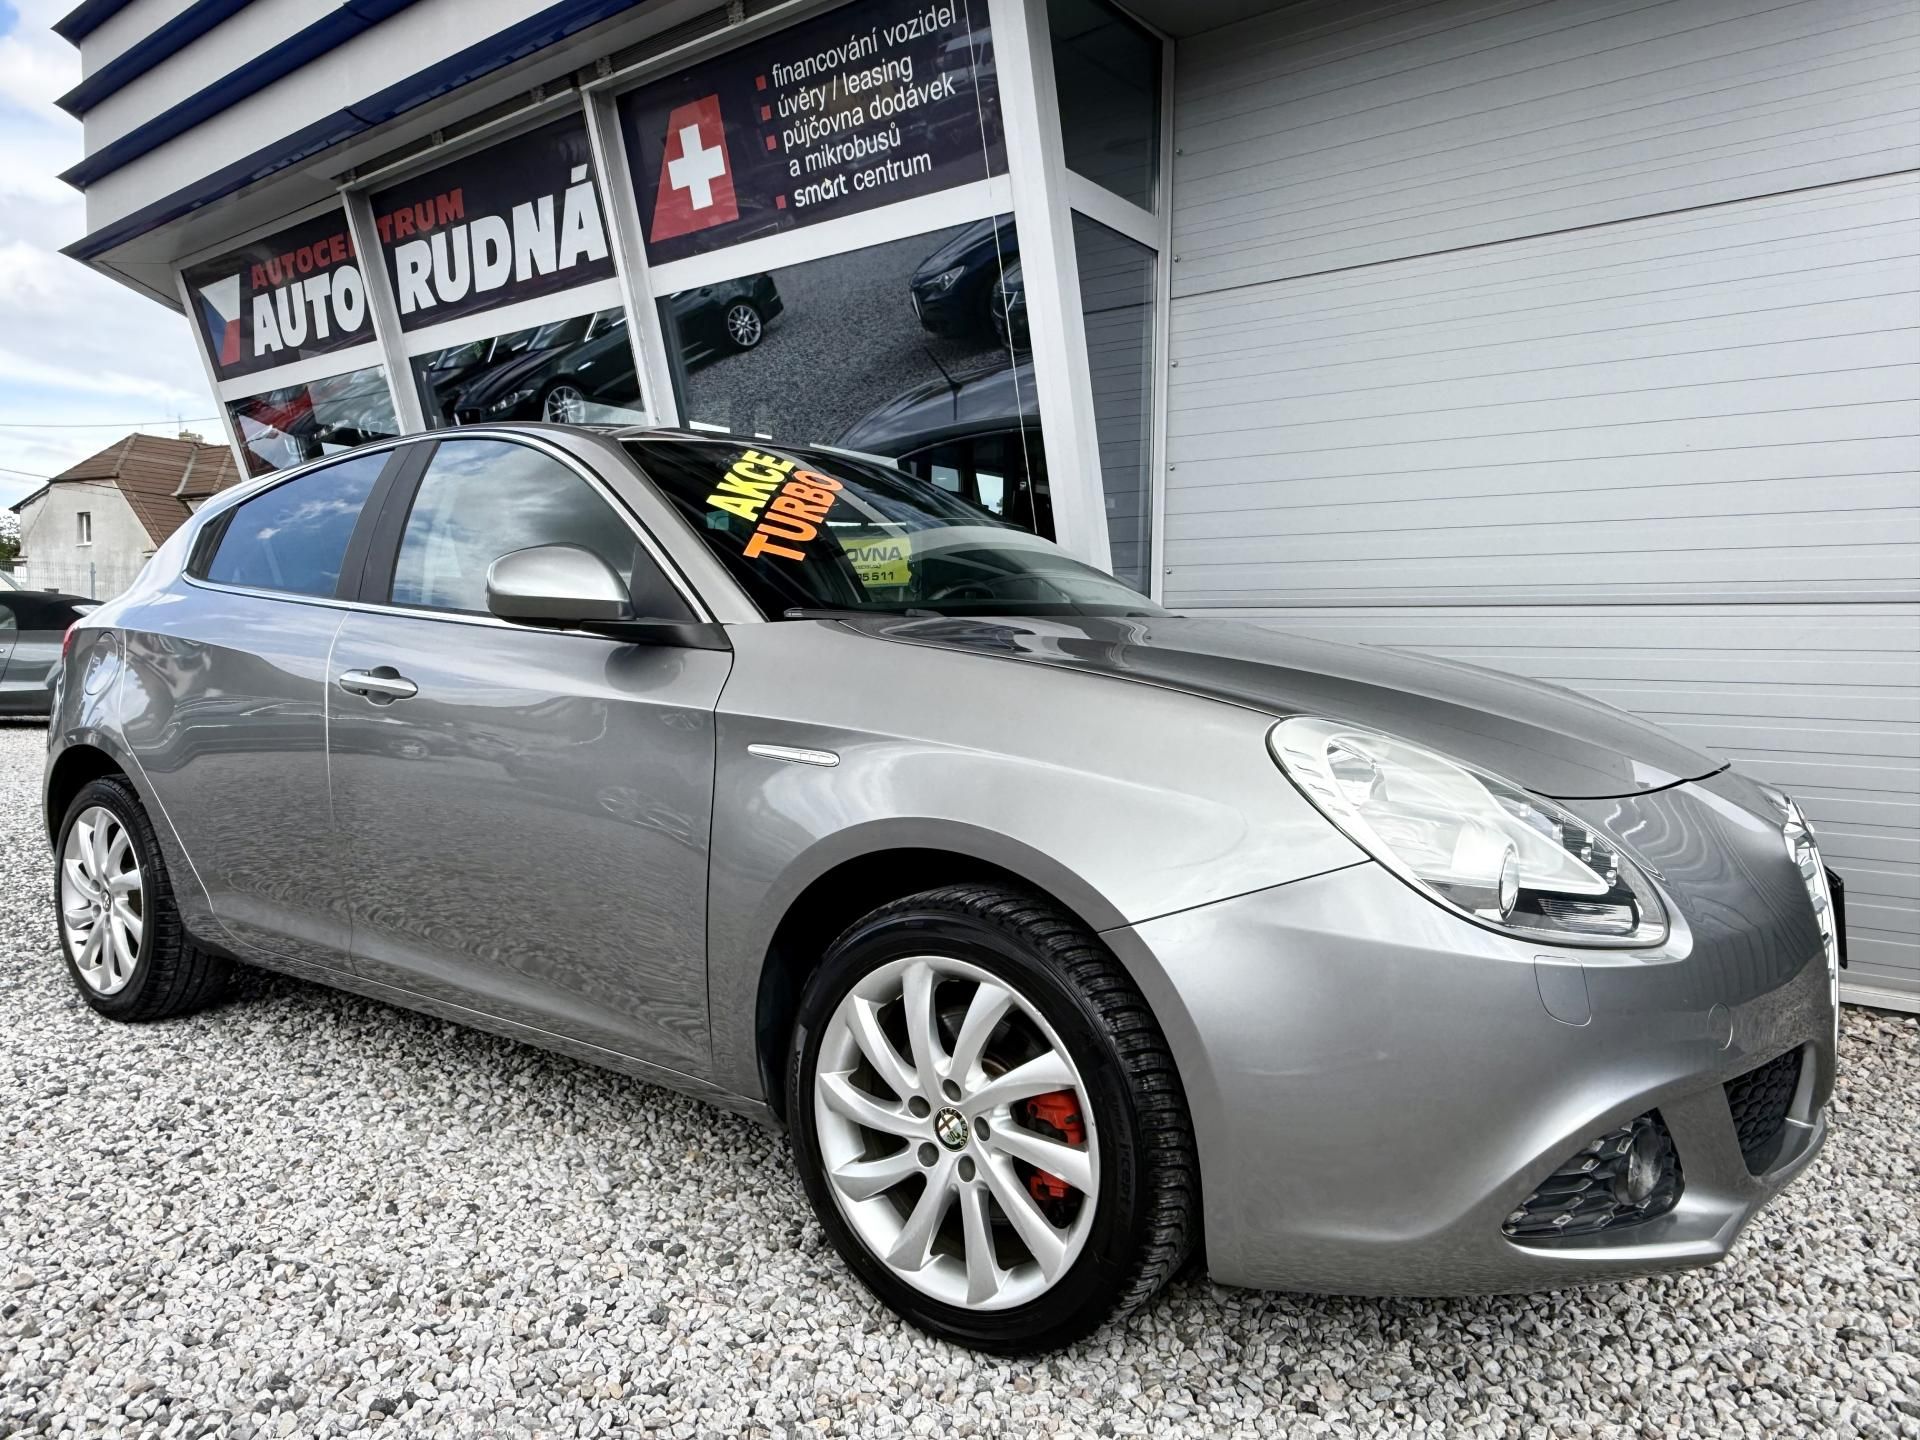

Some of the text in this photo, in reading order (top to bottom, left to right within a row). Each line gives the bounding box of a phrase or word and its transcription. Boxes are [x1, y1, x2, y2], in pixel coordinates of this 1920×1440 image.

[772, 1, 957, 88] financování vozidel
[777, 85, 826, 119] úvěry
[842, 55, 913, 97] leasing
[783, 72, 956, 153] půjčovna dodávek
[789, 121, 901, 177] a mikrobusů
[794, 152, 932, 207] smart centrum
[253, 163, 609, 357] AUTO RUDNÁ
[706, 450, 796, 522] AKCE
[743, 470, 844, 562] TURBO
